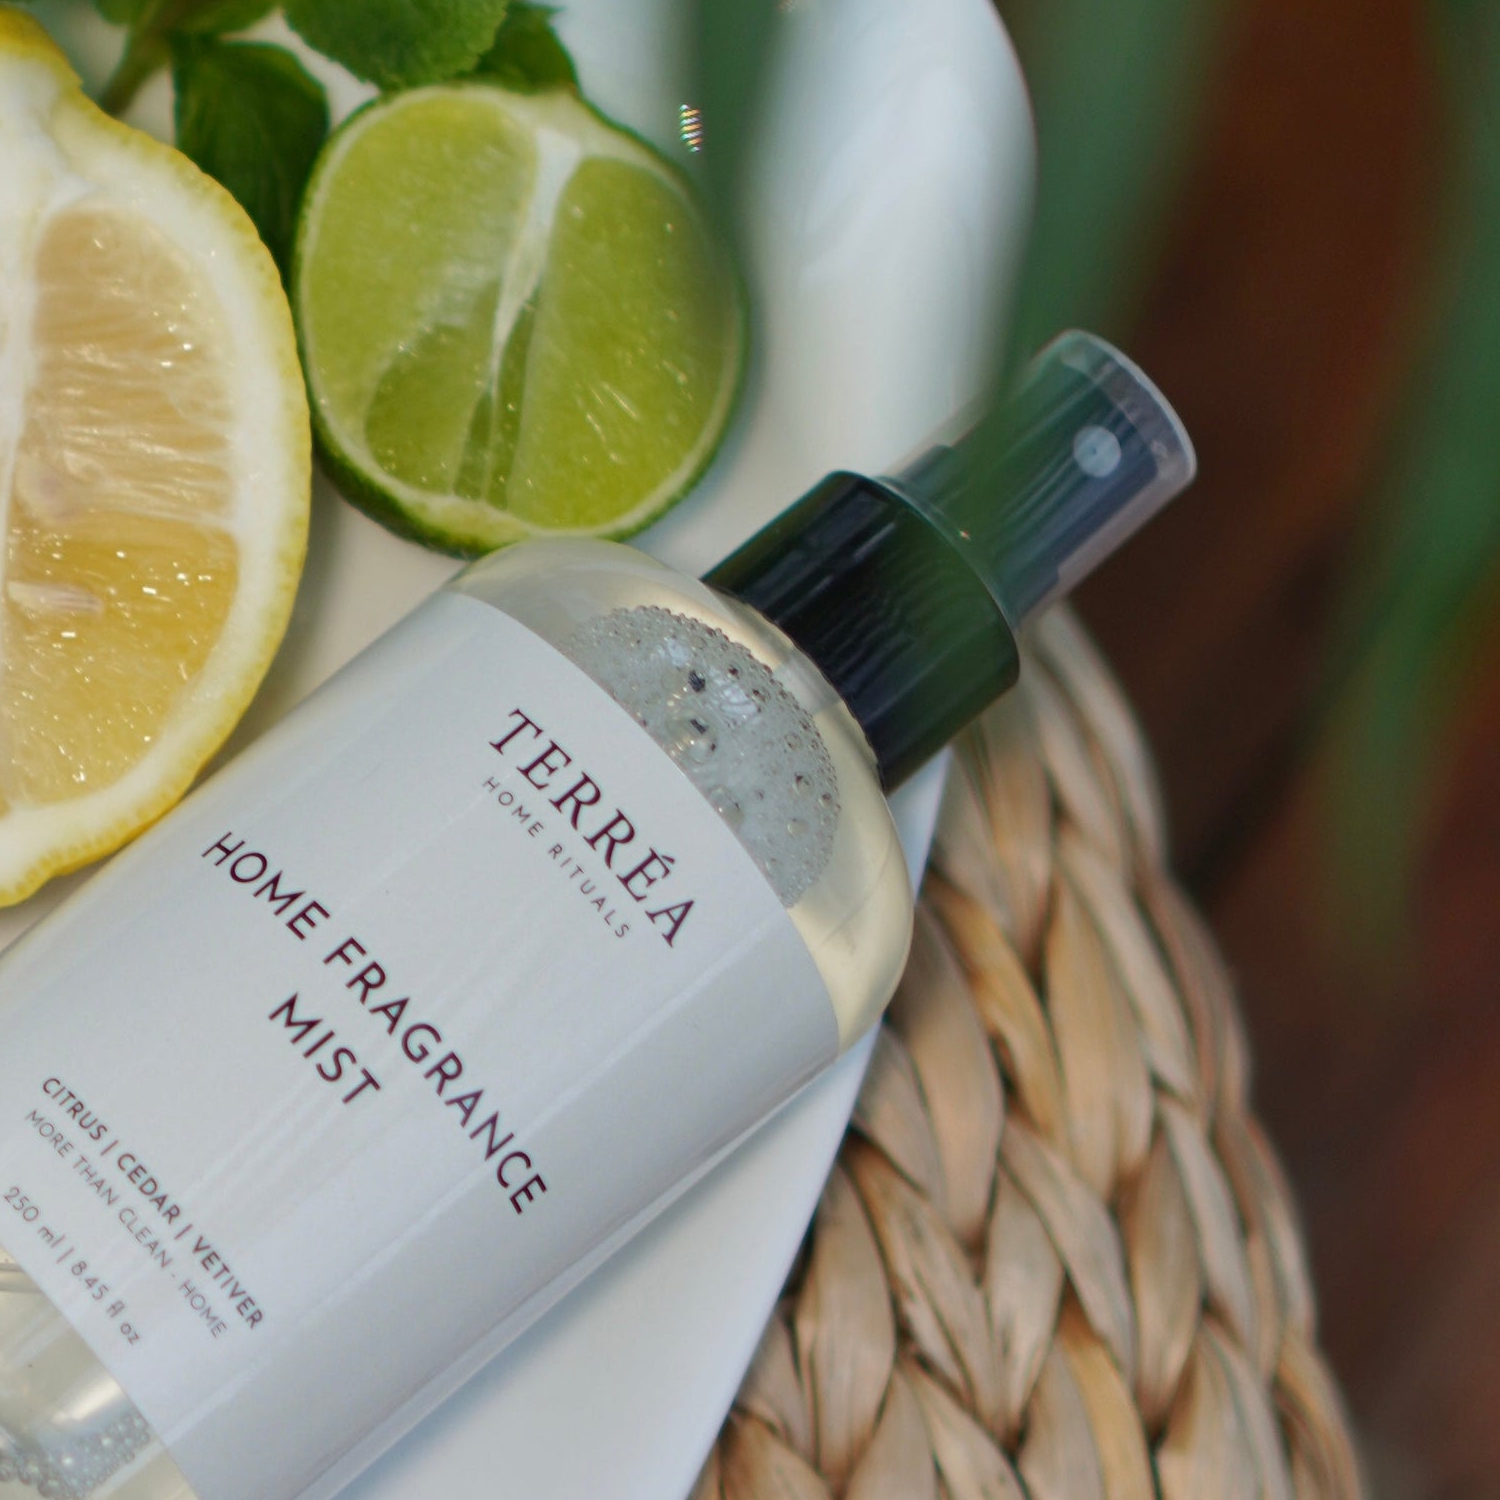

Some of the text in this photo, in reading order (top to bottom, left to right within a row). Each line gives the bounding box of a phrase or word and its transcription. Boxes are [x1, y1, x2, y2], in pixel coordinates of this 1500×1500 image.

[482, 776, 631, 938] HOME RITUALS
[488, 708, 695, 948] TERRÉA
[201, 831, 548, 1215] HOME FRAGRANCE
[268, 991, 381, 1105] MIST
[3, 1186, 40, 1222] 250
[37, 1224, 66, 1249] ml
[70, 1260, 110, 1301] 8.45
[119, 1322, 140, 1345] oz
[25, 1109, 74, 1157] MORE
[72, 1155, 120, 1206] THAN
[118, 1207, 172, 1269] CLEAN
[178, 1279, 228, 1338] HOME
[42, 1077, 108, 1141] CITRUS
[116, 1152, 181, 1224] CEDAR
[191, 1235, 264, 1329] VETIVER
